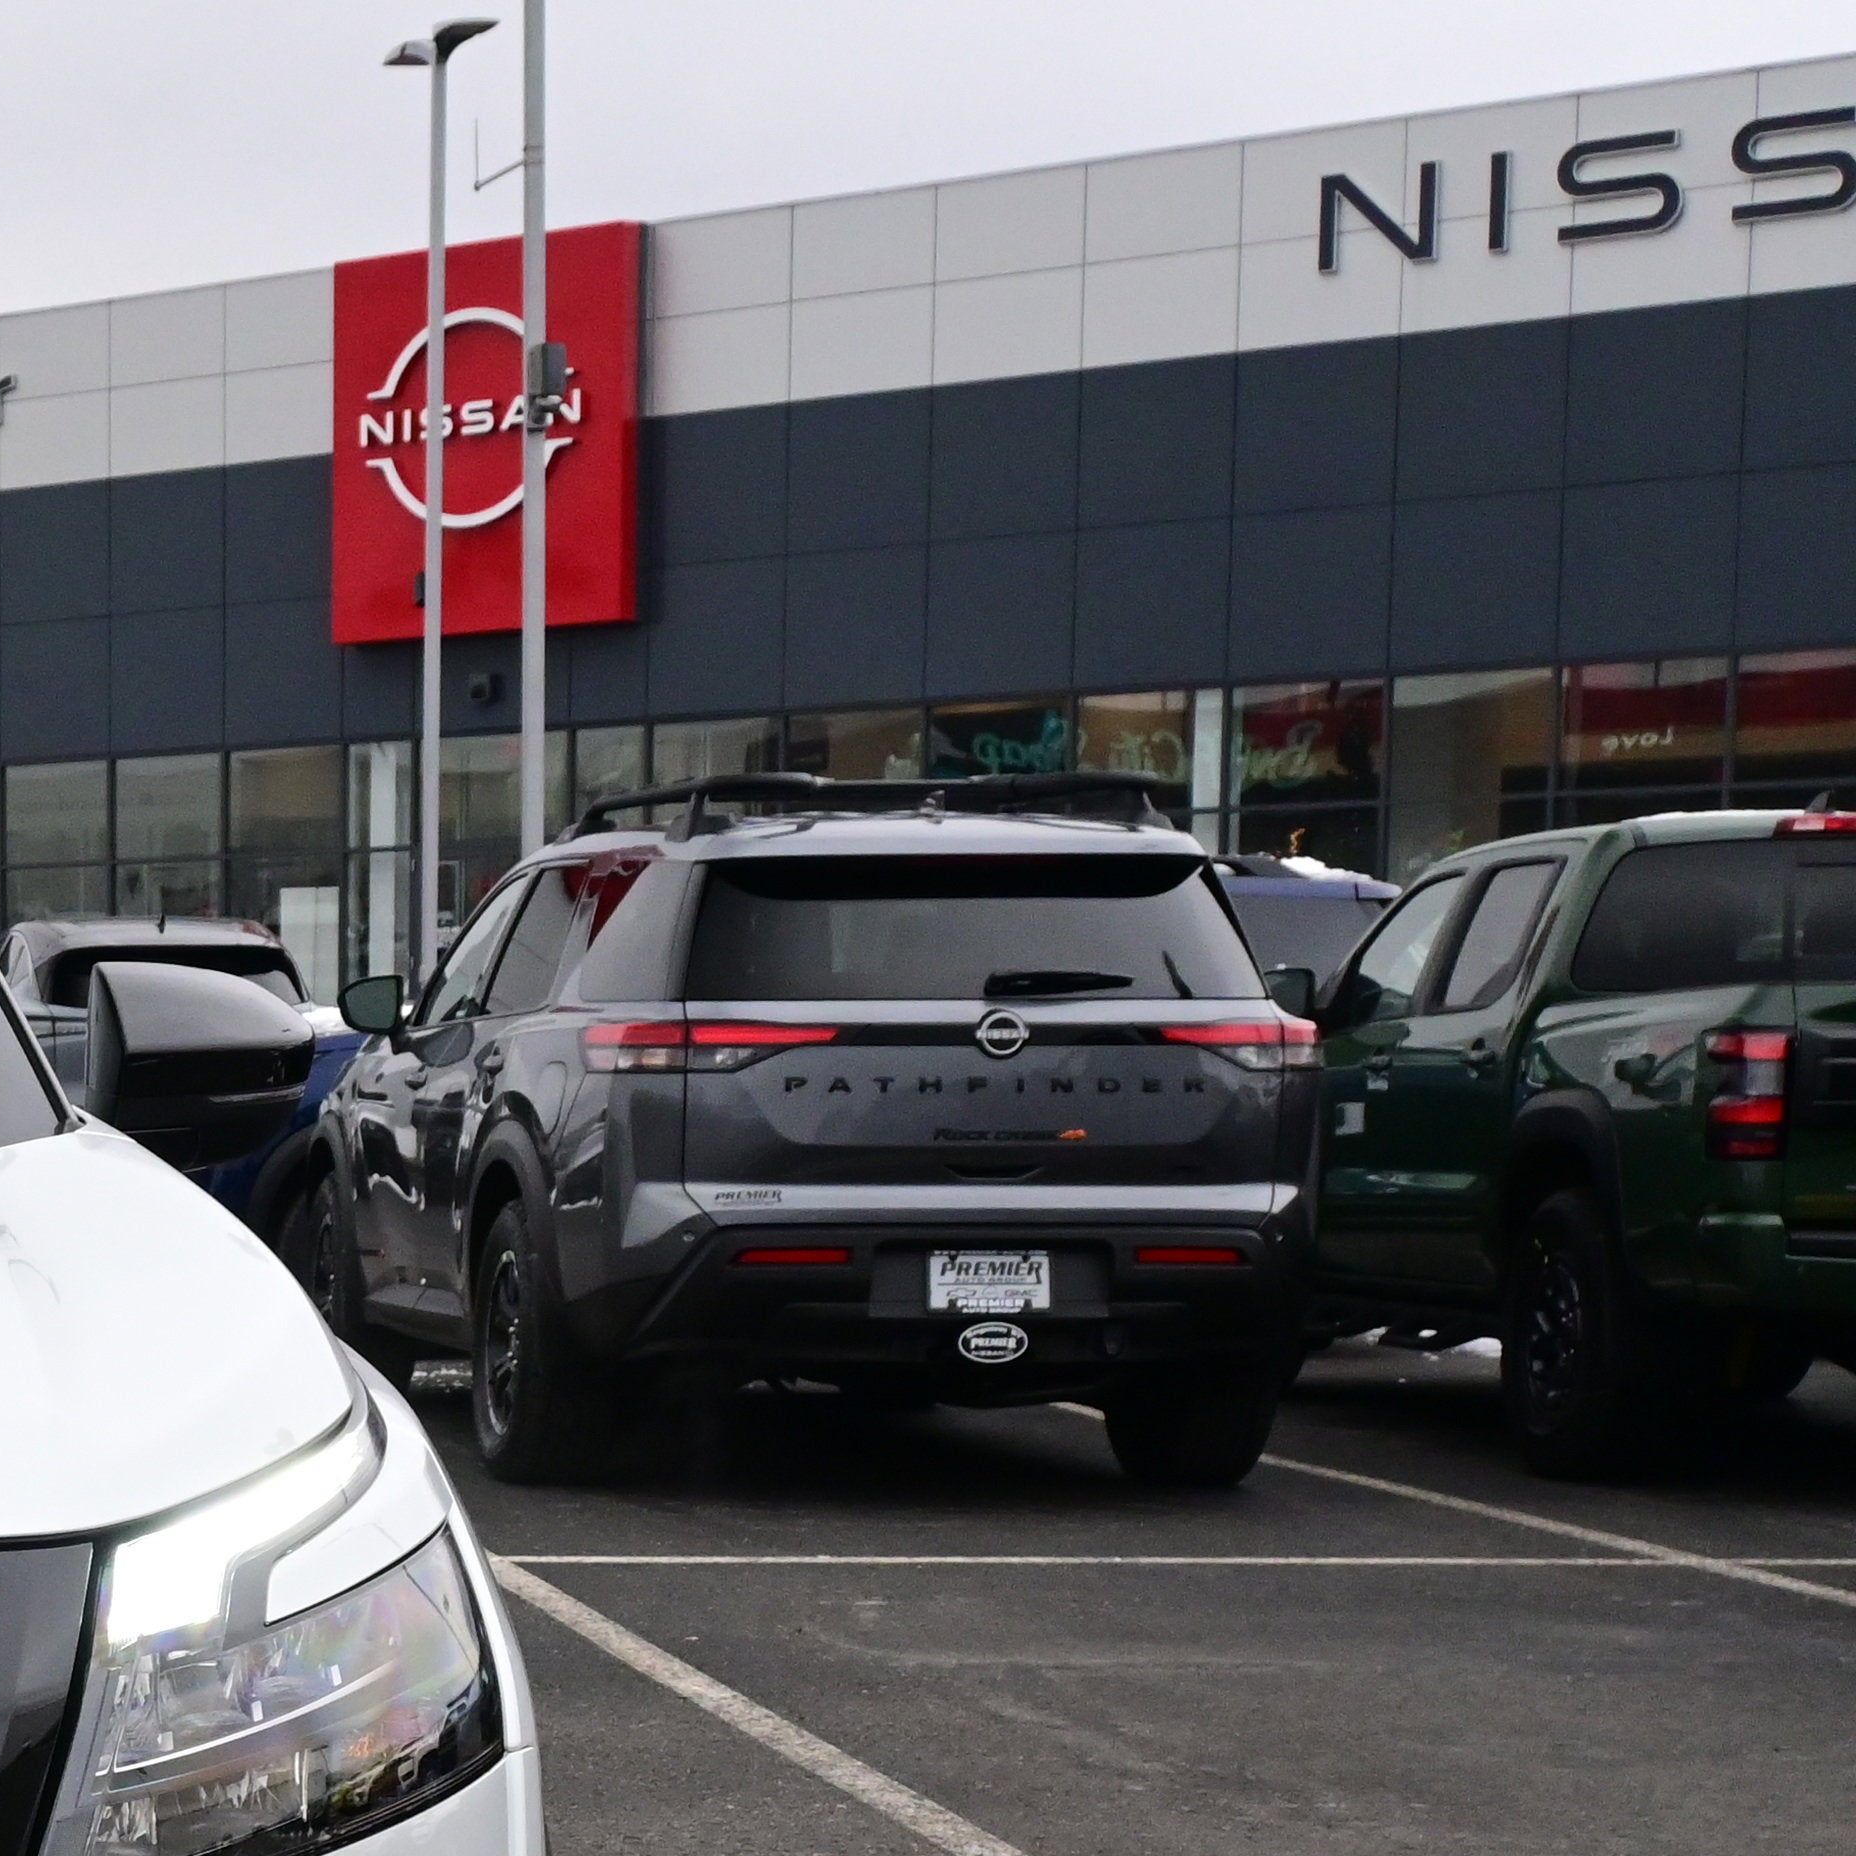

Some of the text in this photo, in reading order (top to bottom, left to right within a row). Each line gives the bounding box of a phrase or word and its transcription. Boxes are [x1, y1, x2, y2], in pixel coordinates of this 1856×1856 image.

[783, 1075, 1209, 1095] PATHFINDER
[714, 1188, 783, 1203] PREMIER
[940, 1260, 1043, 1285] PREMIER
[956, 1298, 1025, 1308] PREMIER
